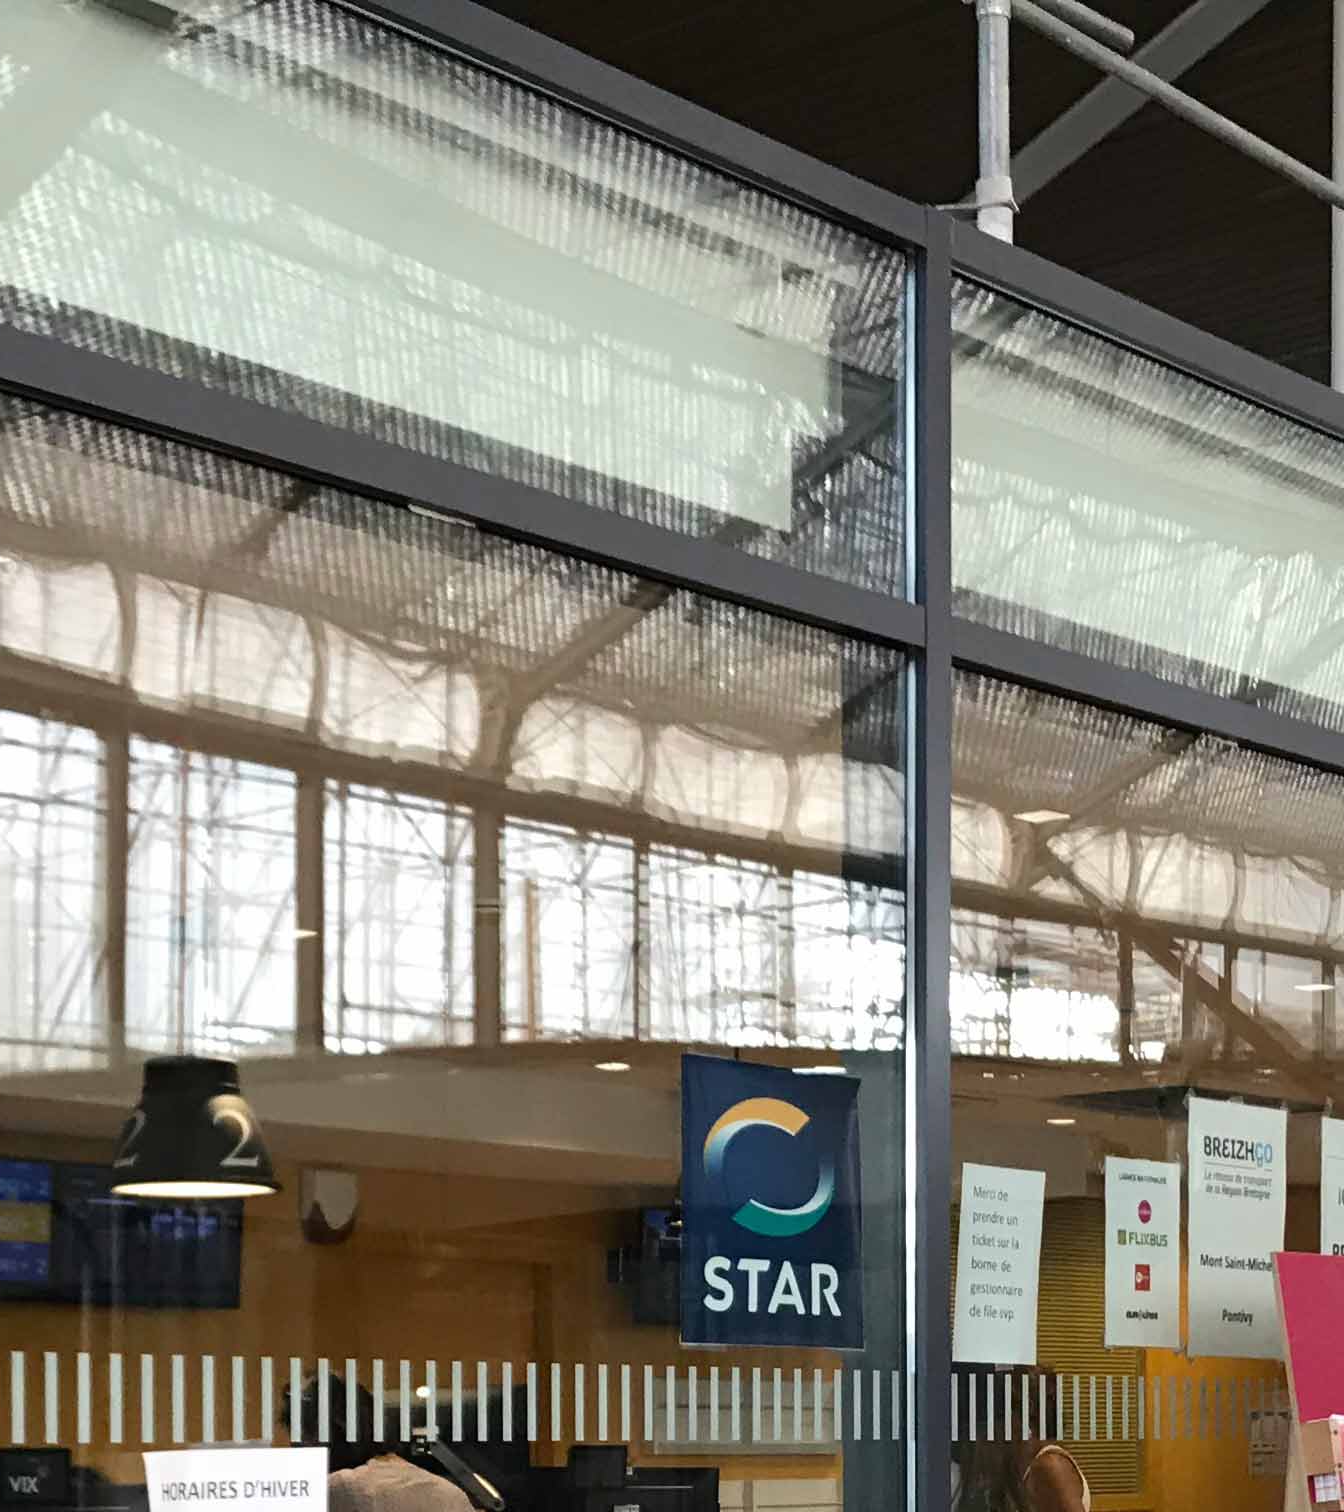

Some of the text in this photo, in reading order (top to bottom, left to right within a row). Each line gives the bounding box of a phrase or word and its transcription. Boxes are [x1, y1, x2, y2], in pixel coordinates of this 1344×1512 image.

[212, 1109, 259, 1168] 2
[973, 1185, 1008, 1202] Merci de
[972, 1211, 1018, 1227] prendre un
[972, 1234, 1020, 1250] ticket sur la
[1129, 1231, 1168, 1247] FLIXBUS
[971, 1256, 1012, 1273] borne de
[1200, 1253, 1273, 1272] Mont Saint-Miche
[703, 1255, 842, 1317] STAR
[969, 1282, 1023, 1298] gestionnaire
[969, 1304, 982, 1319] de
[983, 1304, 998, 1319] file
[1221, 1308, 1254, 1328] Pontivy
[9, 1475, 38, 1493] VIX
[161, 1480, 310, 1501] HORAIRES D'HIVER
